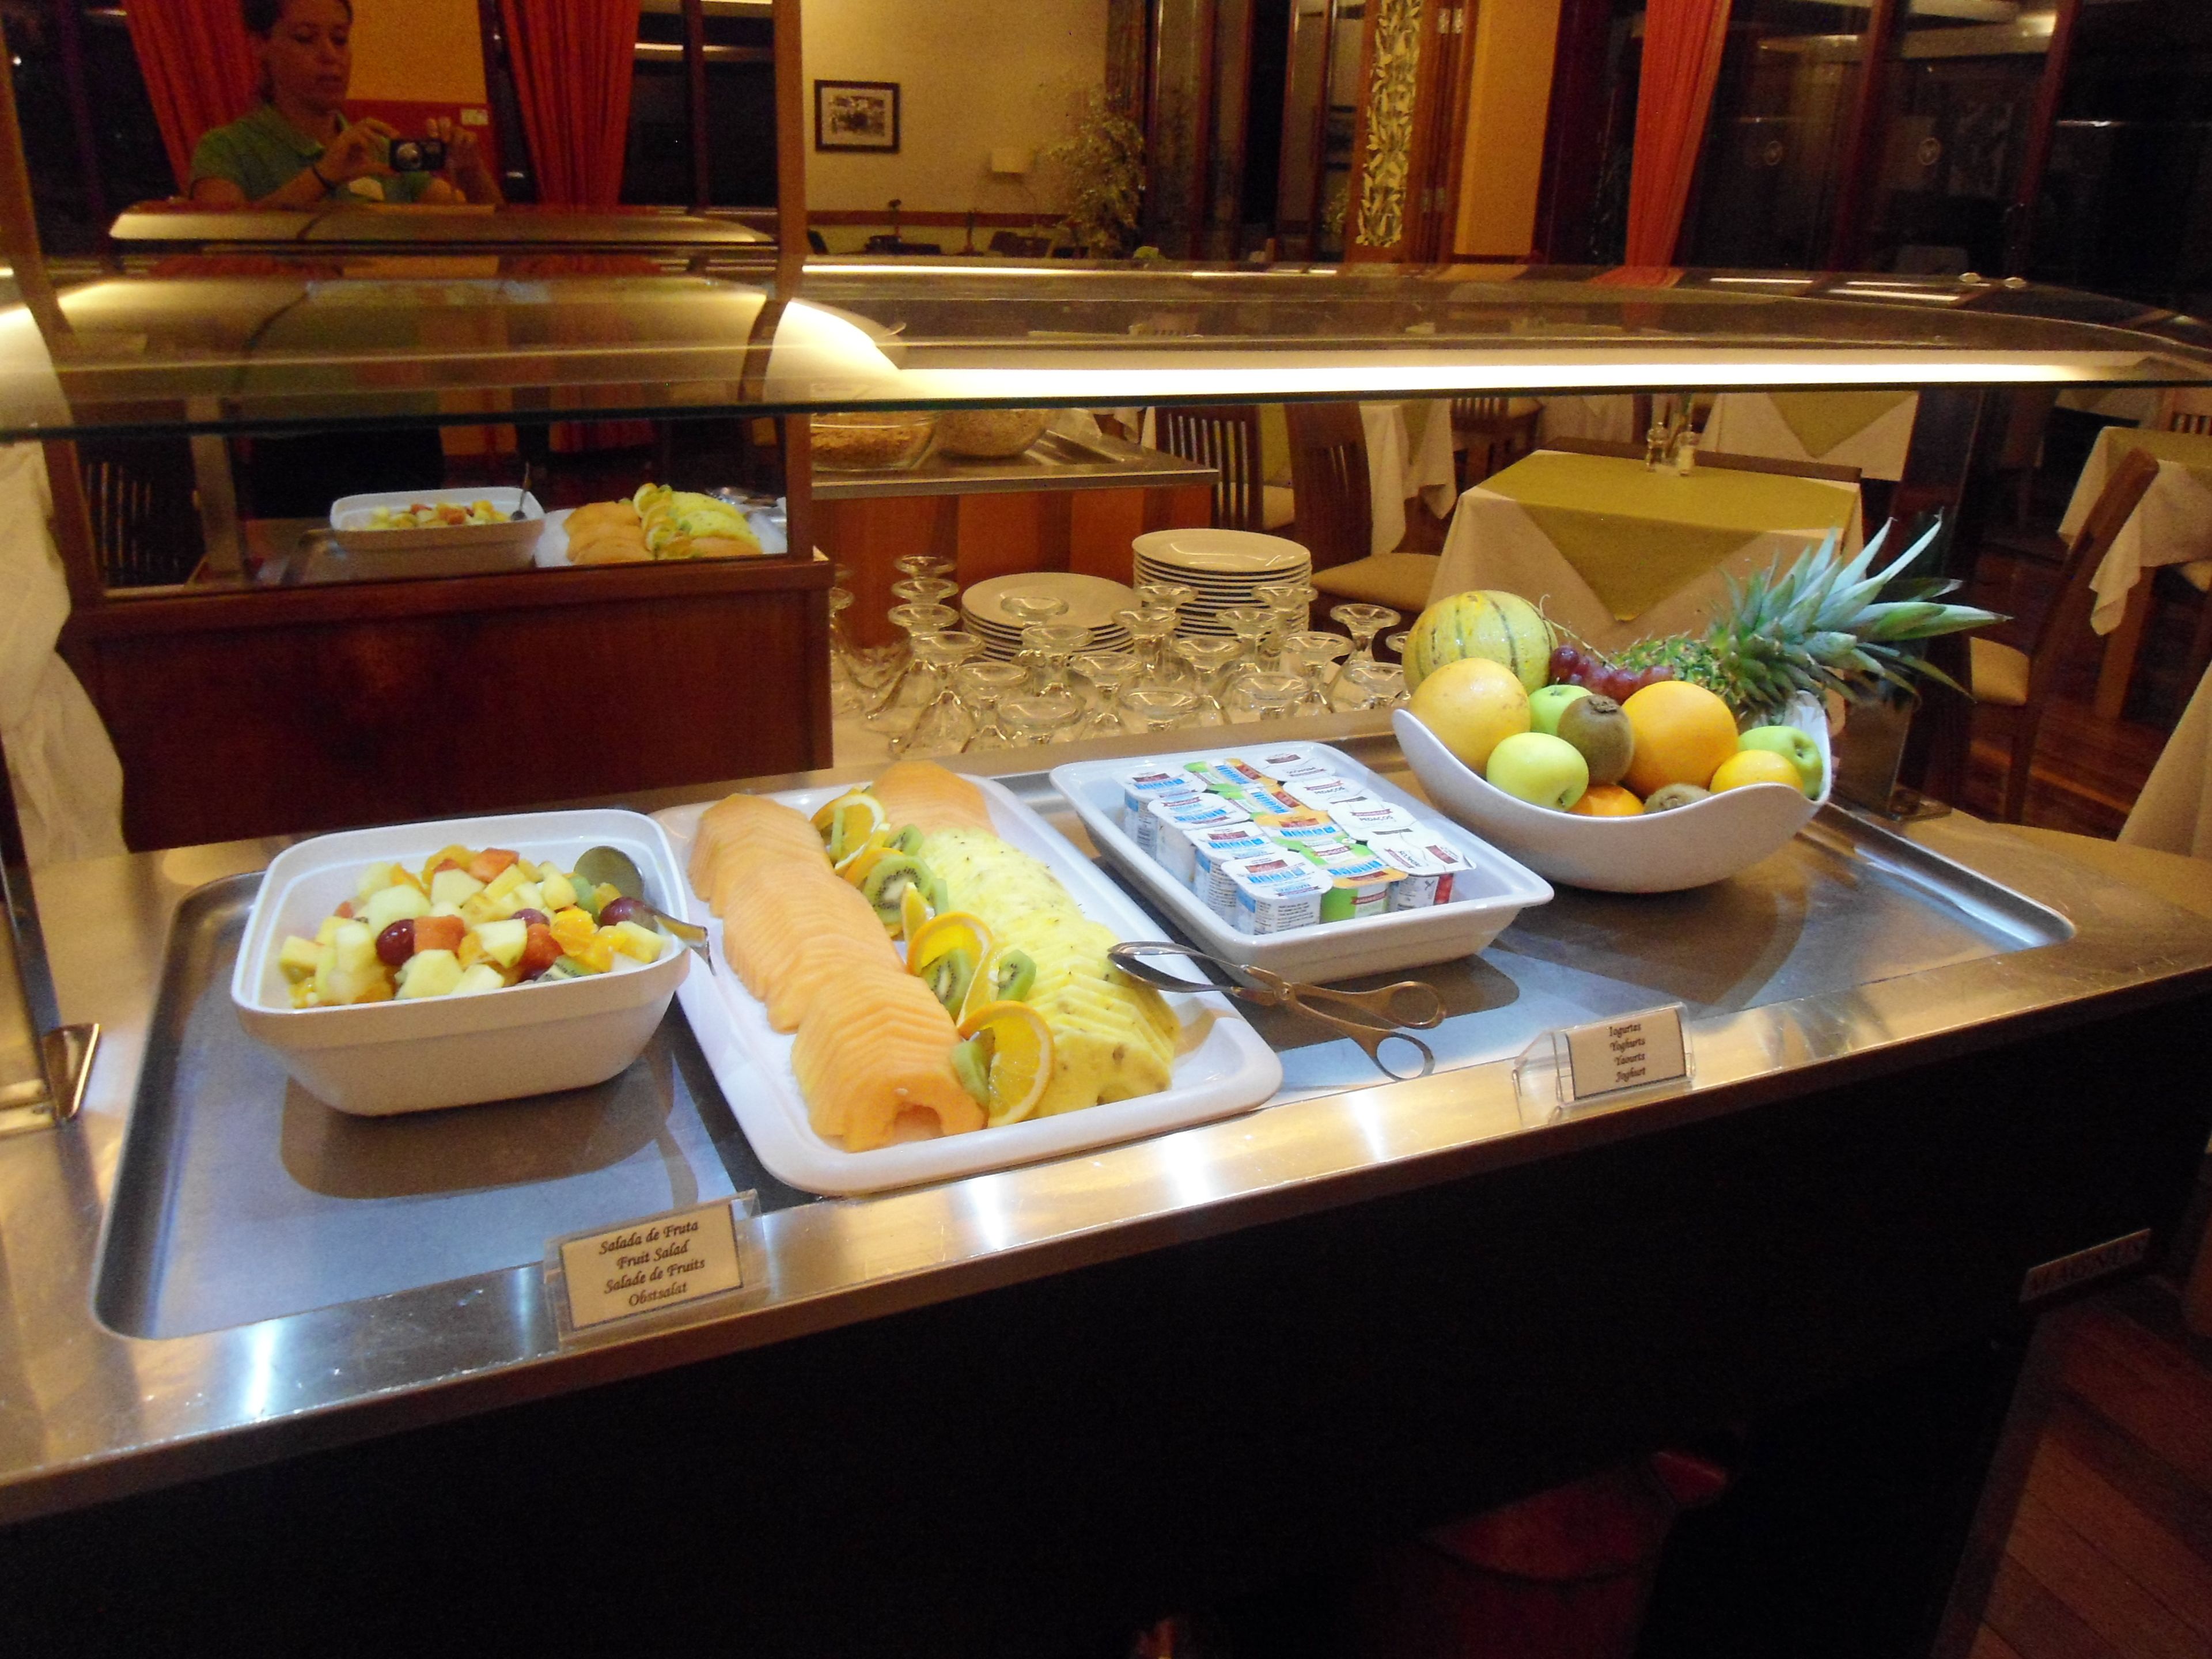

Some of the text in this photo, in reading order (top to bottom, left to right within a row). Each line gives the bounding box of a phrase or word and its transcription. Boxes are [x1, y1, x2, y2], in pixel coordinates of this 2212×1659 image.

[1609, 1037, 1645, 1053] Yoghurts
[1615, 1054, 1645, 1066] Yaourts
[1616, 1067, 1645, 1082] Joghurt
[599, 1220, 699, 1255] Salada de Fruta
[616, 1240, 688, 1270] Fruit Salad
[604, 1258, 705, 1294] Salade de Fruits
[628, 1282, 687, 1306] Obstsalat
